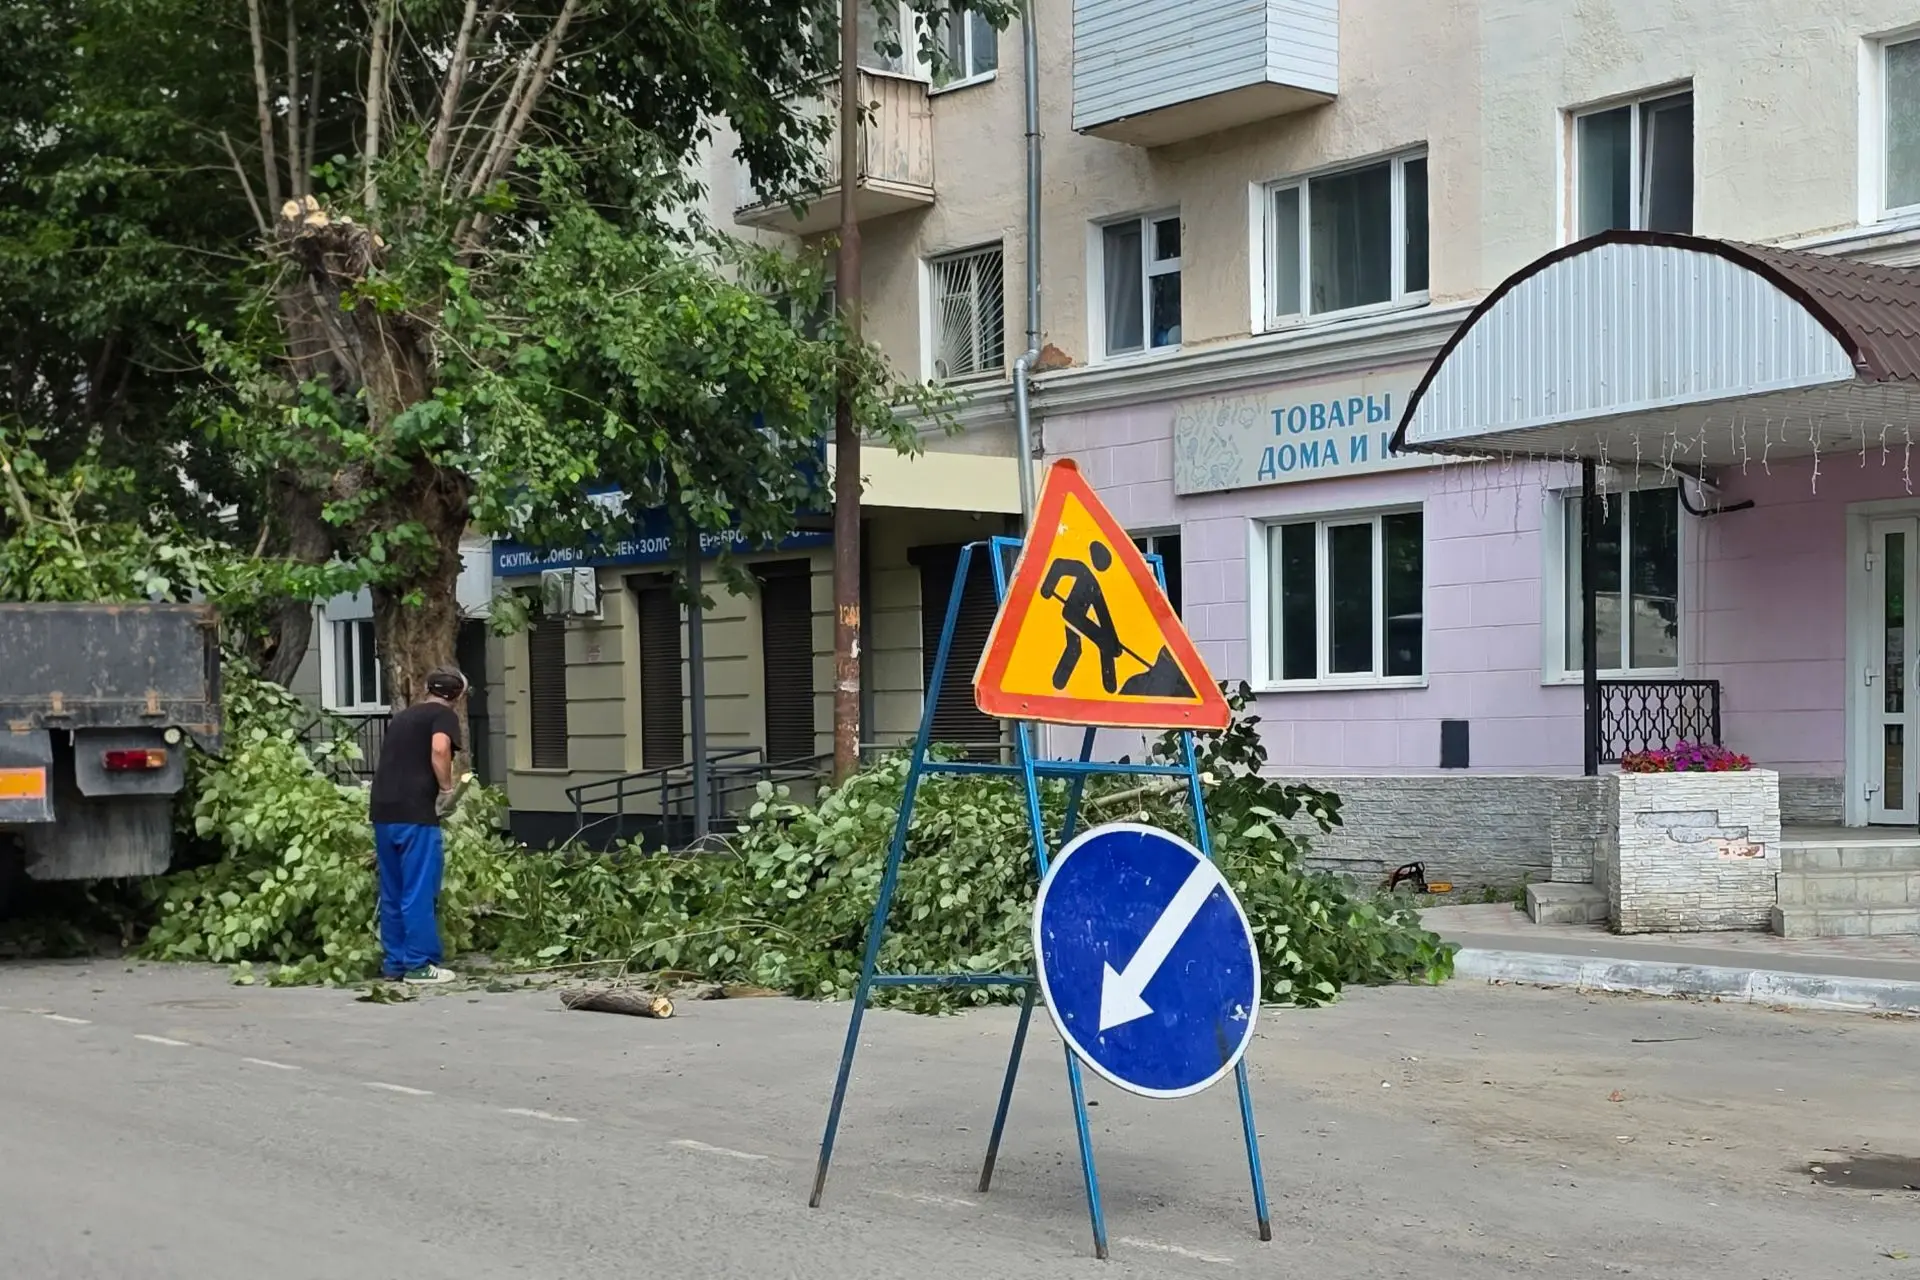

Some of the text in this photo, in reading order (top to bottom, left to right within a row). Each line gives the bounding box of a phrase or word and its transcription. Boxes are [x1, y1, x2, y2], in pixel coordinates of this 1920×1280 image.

[1271, 393, 1391, 436] ТОВАРЫ
[1258, 438, 1340, 481] ДОМА
[1350, 434, 1368, 464] И
